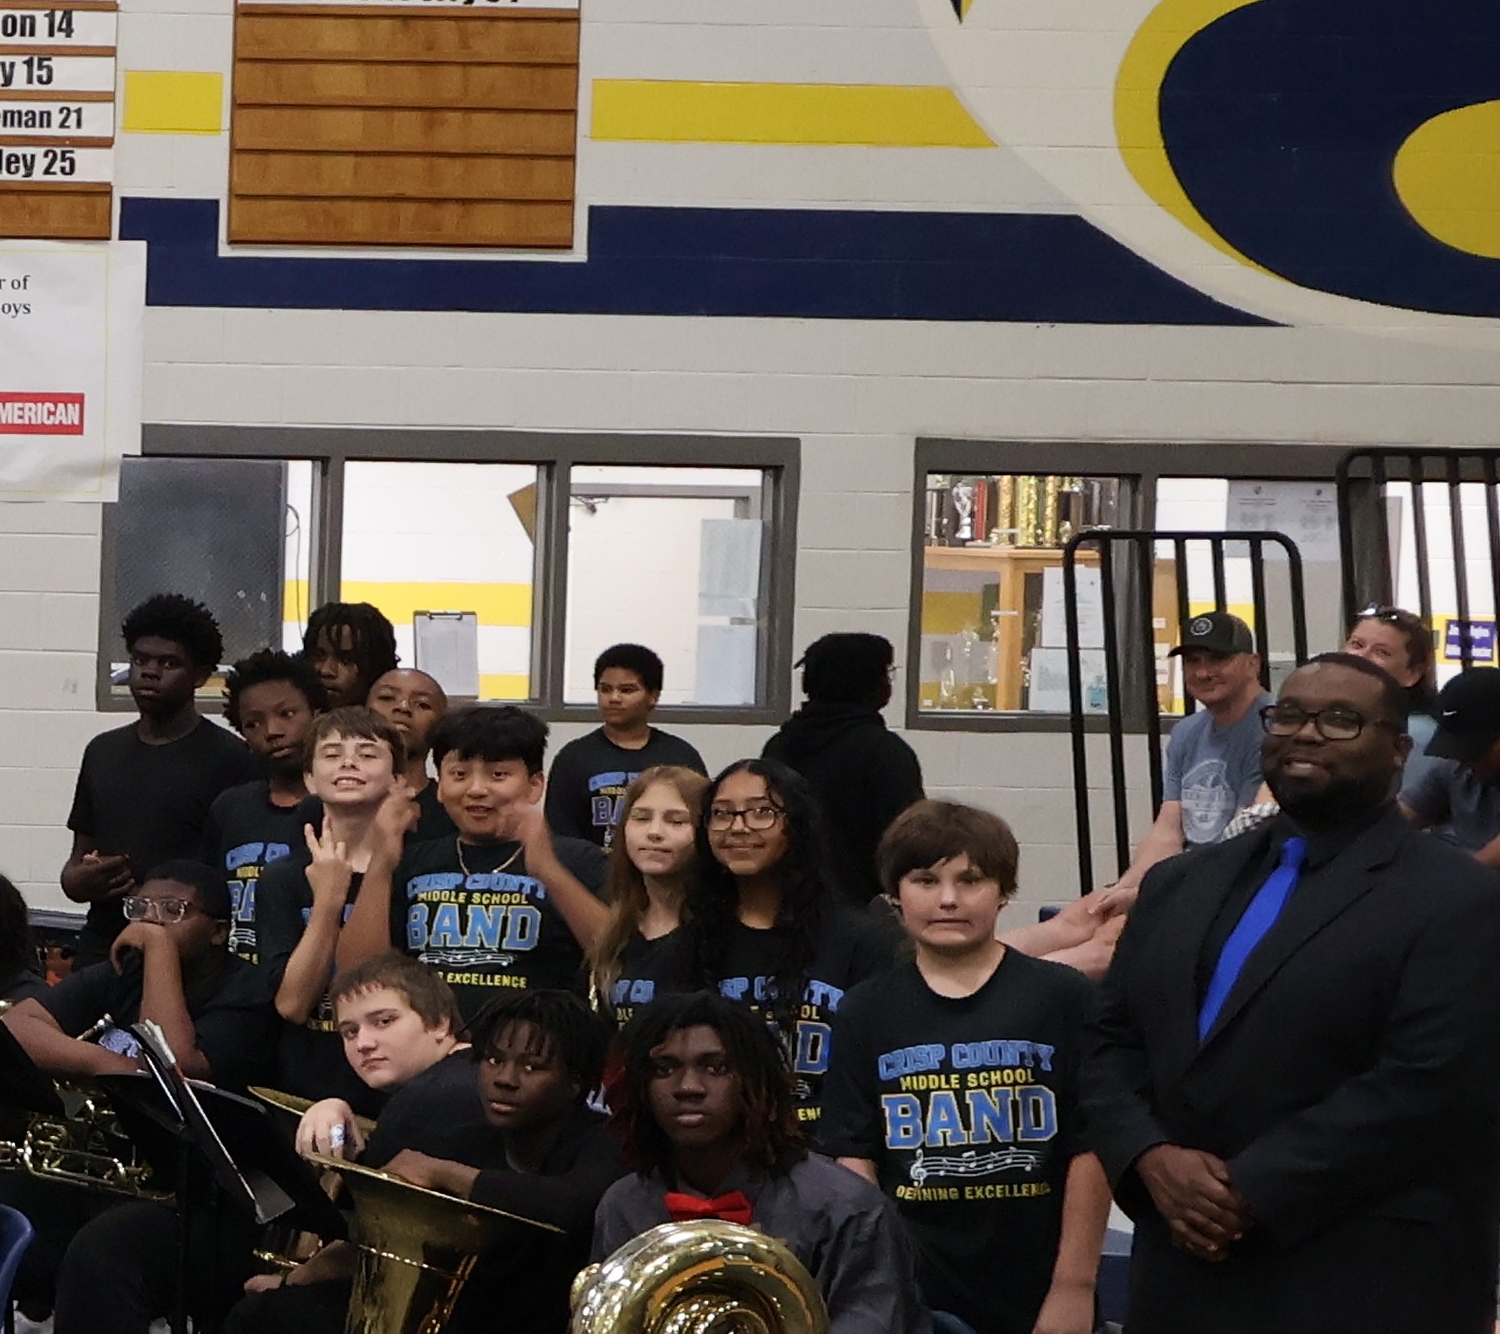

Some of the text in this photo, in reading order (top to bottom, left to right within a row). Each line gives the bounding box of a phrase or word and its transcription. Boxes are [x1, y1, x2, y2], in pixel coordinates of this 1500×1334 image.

[43, 10, 74, 38] 14
[22, 57, 53, 85] 15
[59, 107, 82, 129] 21
[43, 149, 75, 176] 25
[11, 275, 30, 290] of
[417, 891, 529, 904] MIDDLE SCHOOL
[407, 903, 542, 951] BAND
[447, 973, 527, 988] EXCELLENCE
[878, 1040, 1055, 1080] CRISP COUNTY
[900, 1069, 1035, 1090] MIDDLE SCHOOL
[881, 1085, 1058, 1149] BAND
